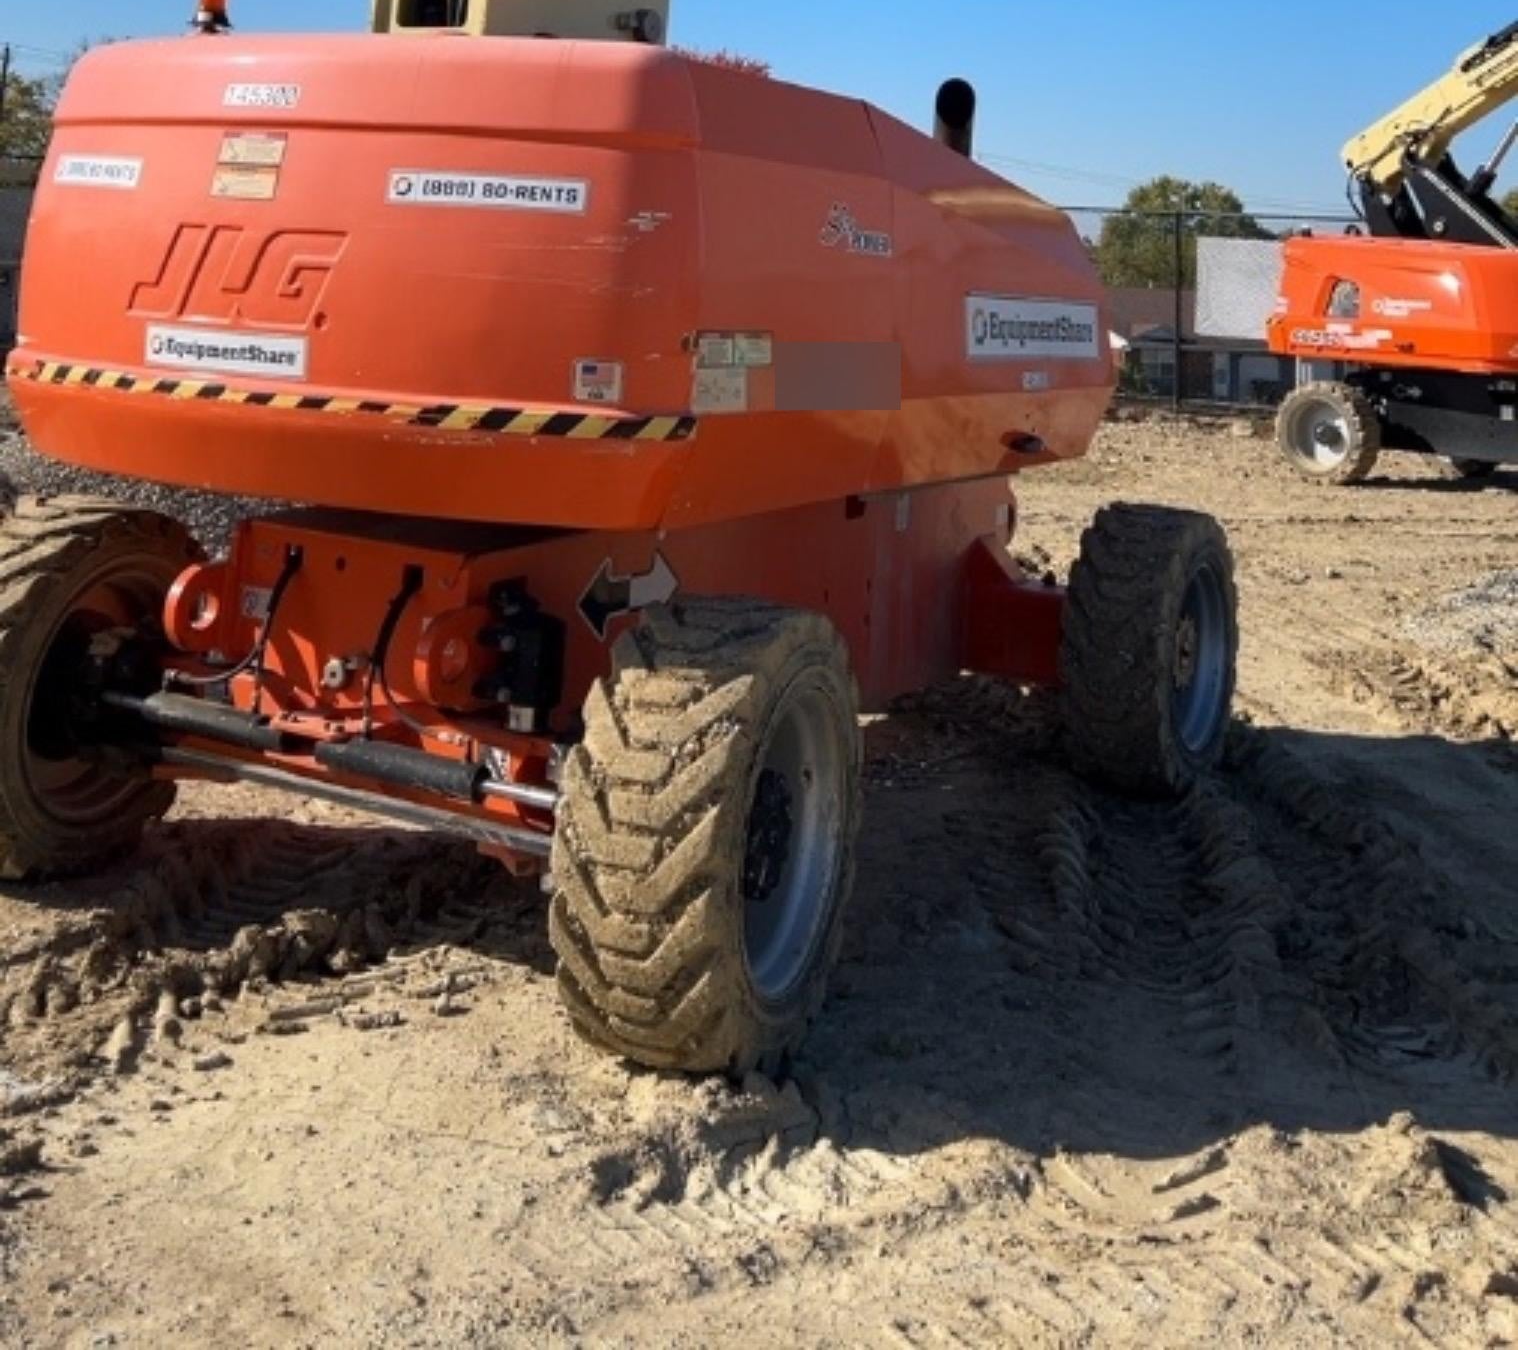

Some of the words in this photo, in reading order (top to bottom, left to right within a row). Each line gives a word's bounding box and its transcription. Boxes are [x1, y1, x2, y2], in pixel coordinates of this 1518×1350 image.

[126, 222, 350, 331] JLG
[990, 311, 1094, 348] EquipmentShare
[165, 336, 297, 366] EquipmentShare
